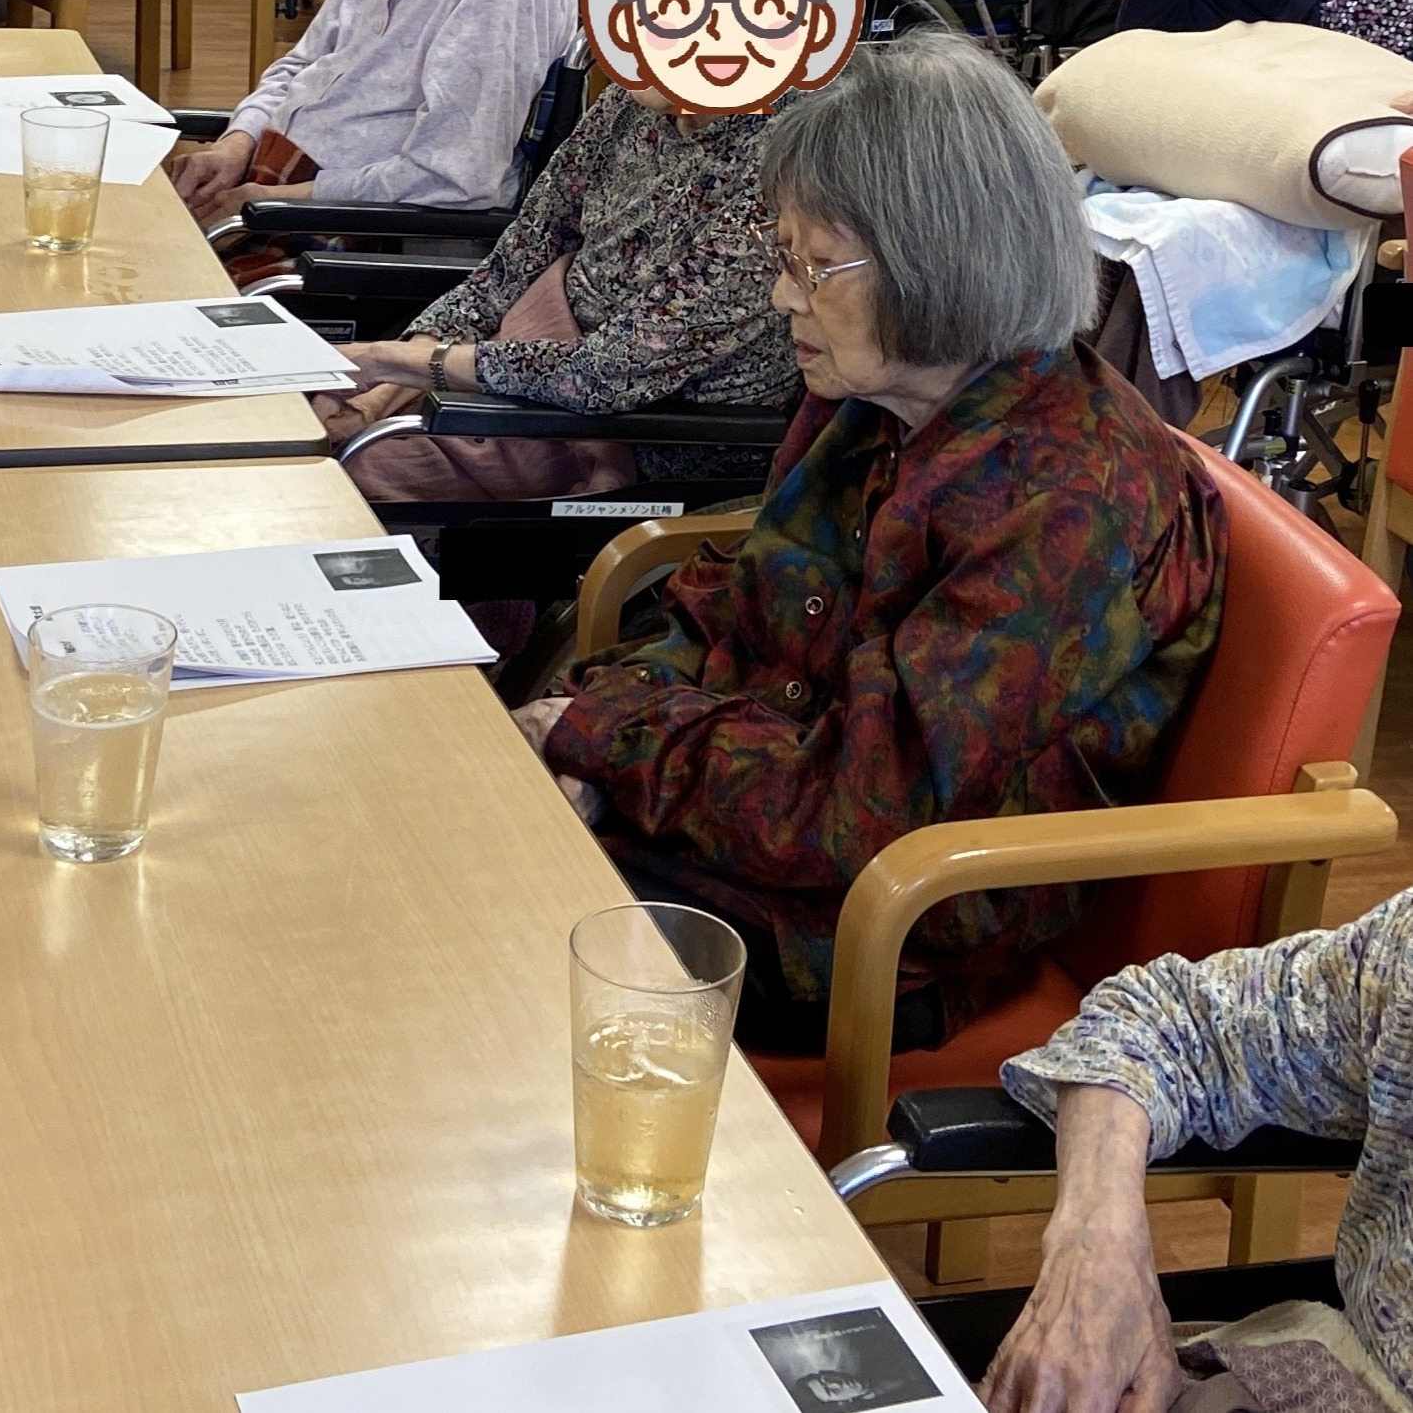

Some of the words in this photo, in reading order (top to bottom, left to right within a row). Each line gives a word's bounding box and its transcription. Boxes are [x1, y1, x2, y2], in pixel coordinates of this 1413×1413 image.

[564, 504, 673, 516] アルジャンメゾン紅梅
